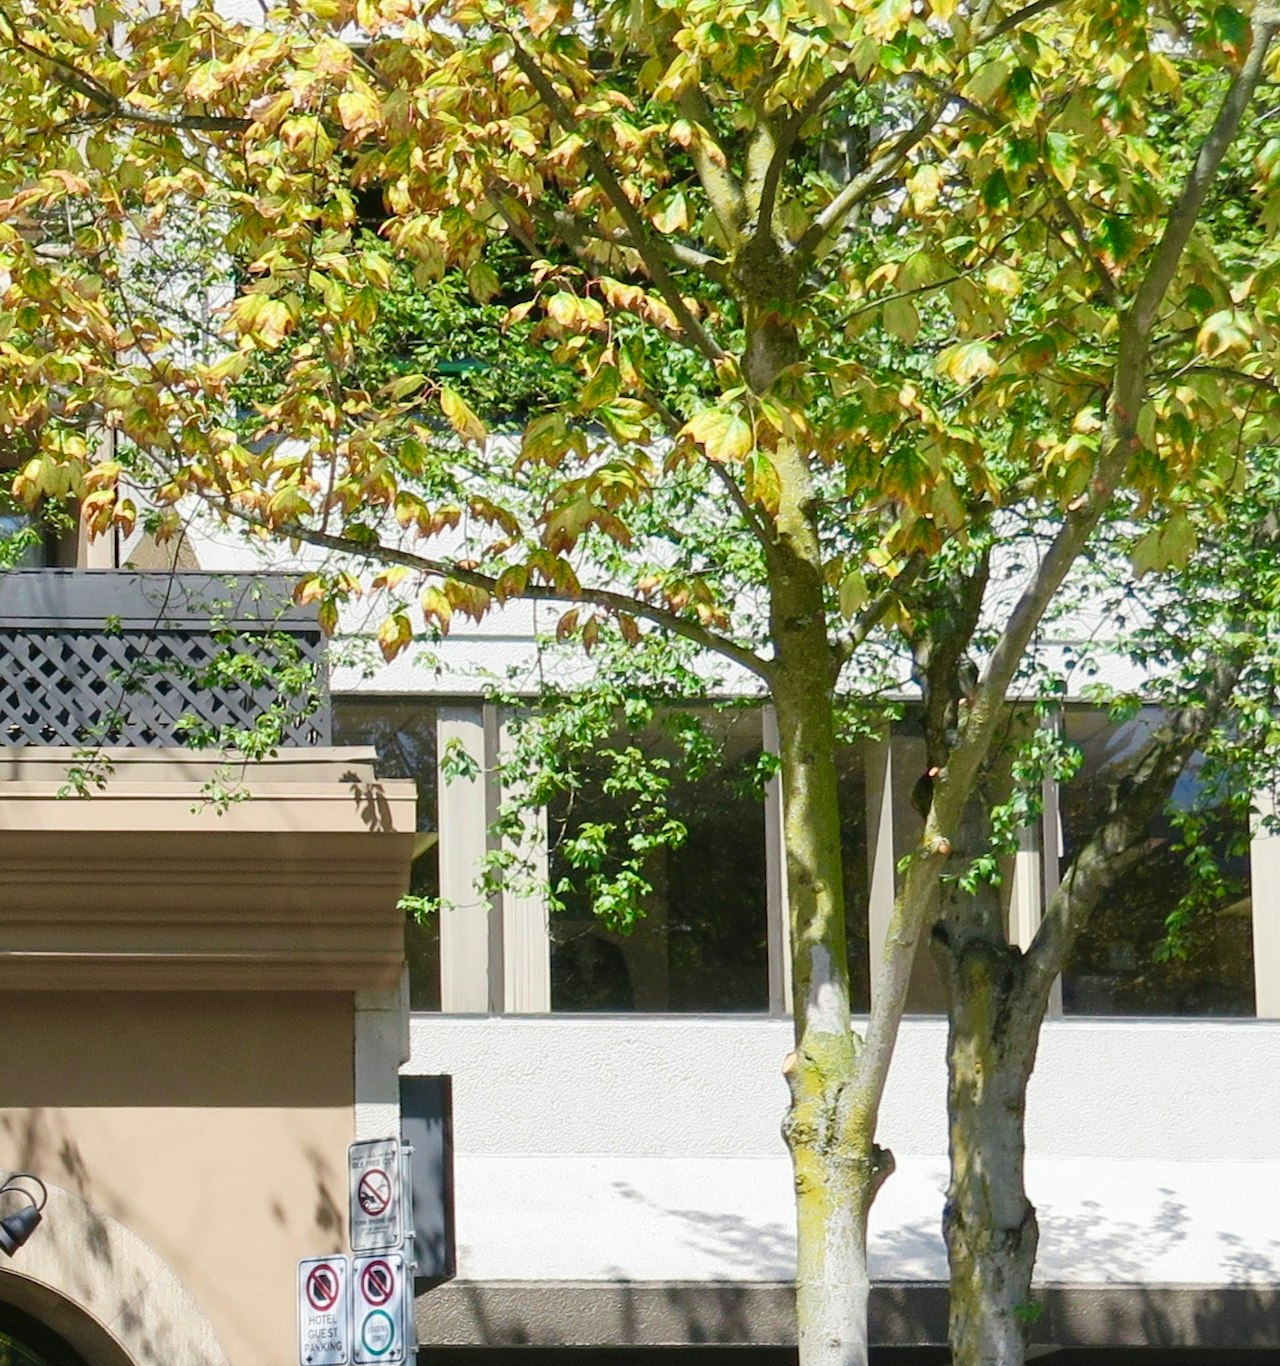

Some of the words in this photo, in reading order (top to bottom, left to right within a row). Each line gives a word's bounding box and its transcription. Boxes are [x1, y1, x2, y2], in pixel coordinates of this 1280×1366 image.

[308, 1314, 338, 1325] HOTEL
[307, 1328, 338, 1339] GUEST
[304, 1341, 343, 1353] PARKING
